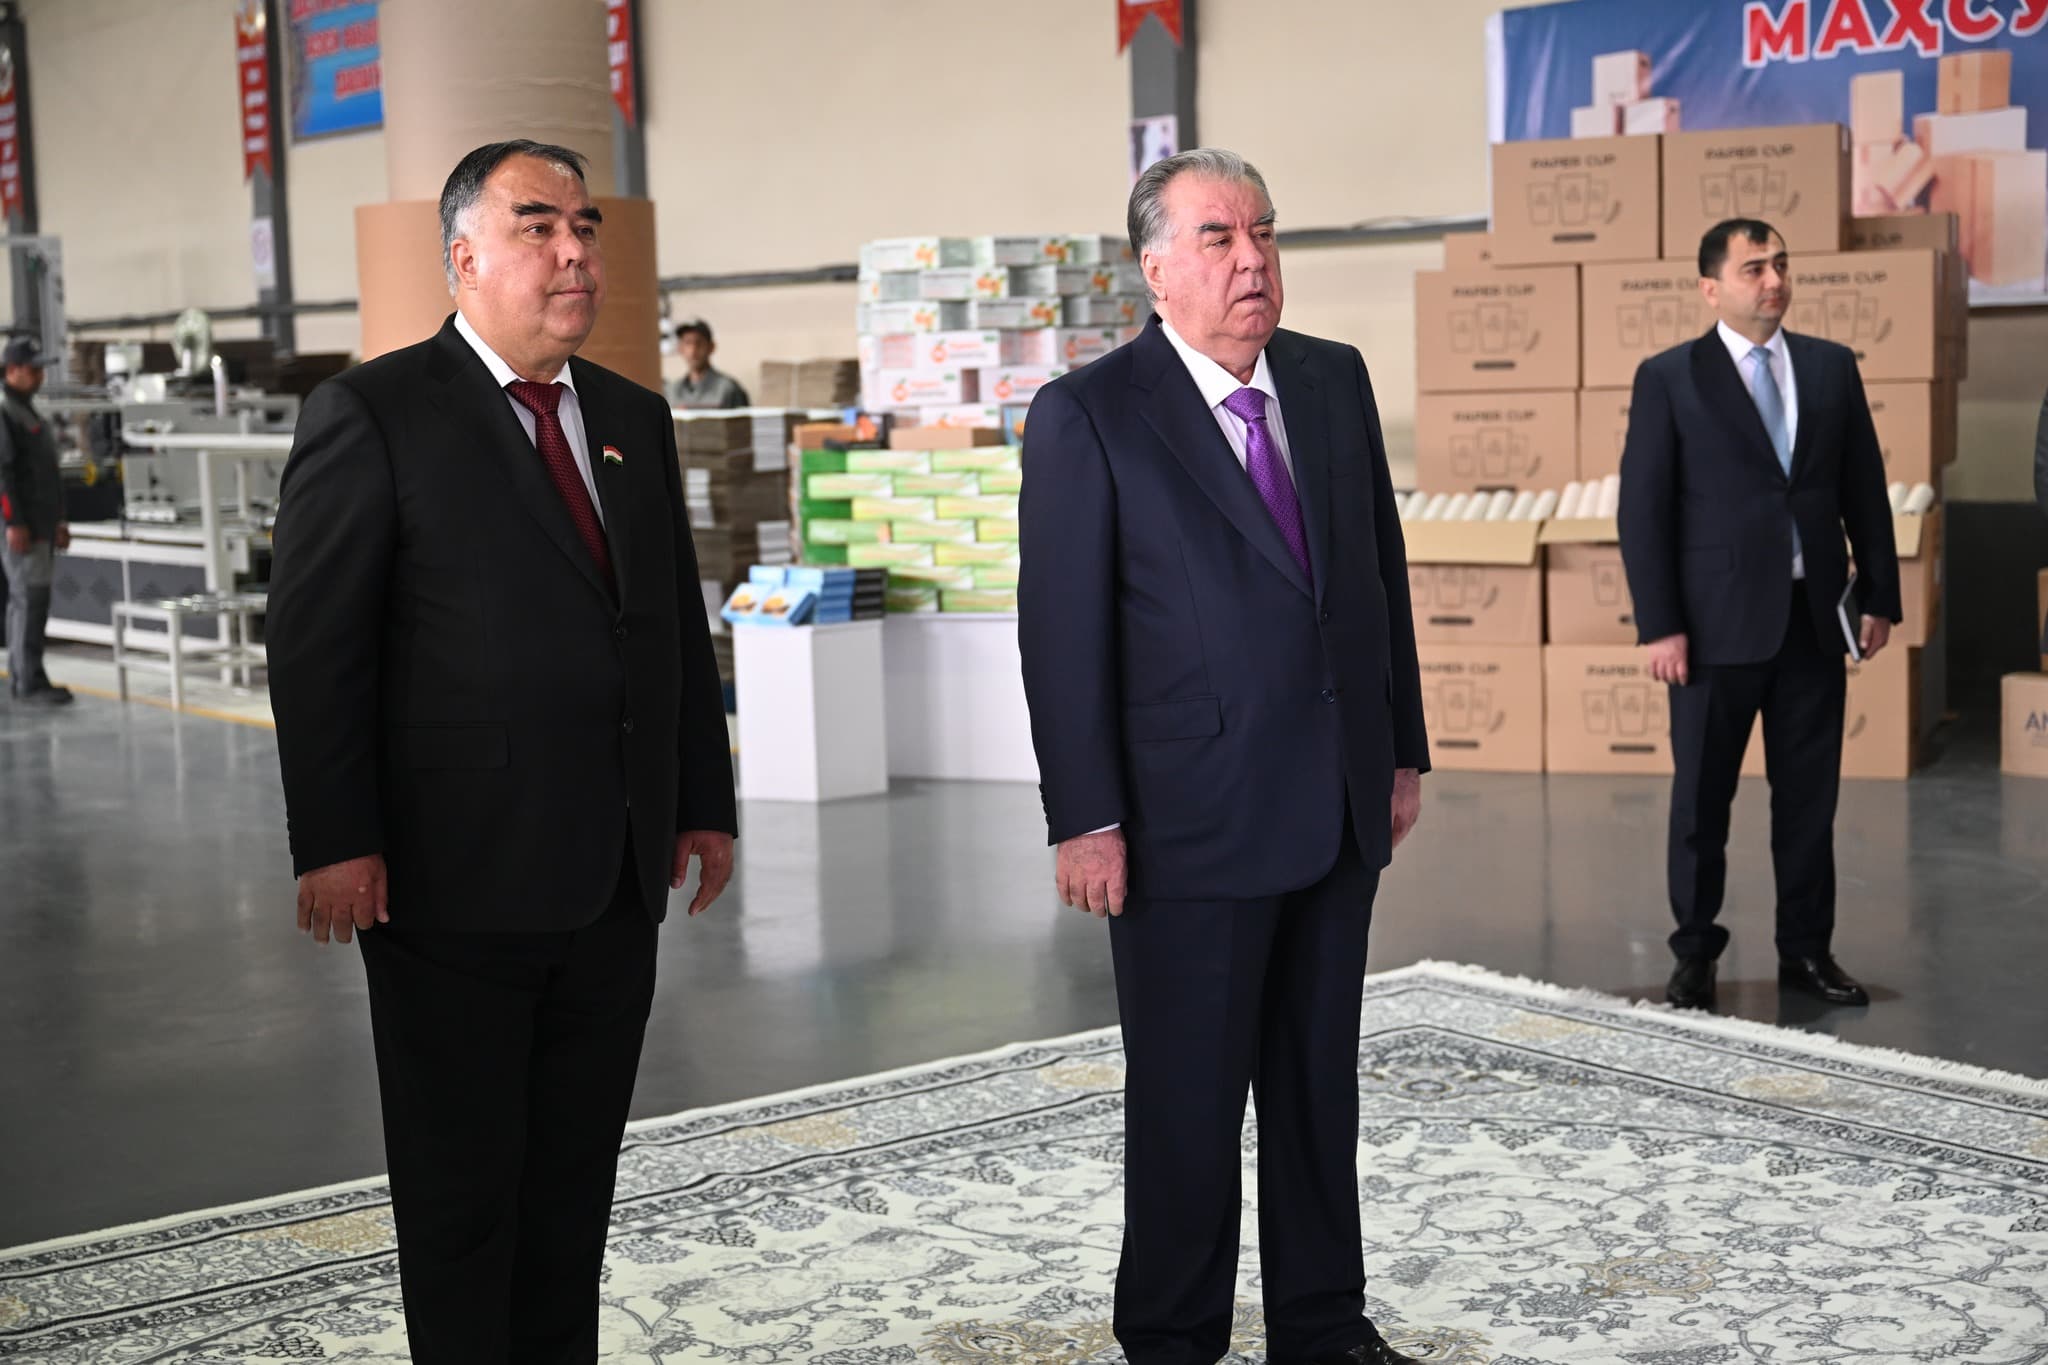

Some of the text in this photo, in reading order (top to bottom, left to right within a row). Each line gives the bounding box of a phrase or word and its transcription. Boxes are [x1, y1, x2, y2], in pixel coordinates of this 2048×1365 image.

[1705, 144, 1794, 160] PAPER CUP
[1531, 154, 1617, 169] PAPER CUP
[1622, 279, 1673, 292] PAPER
[1797, 271, 1887, 286] PAPER CUP
[1453, 284, 1536, 297] PAPER CUP
